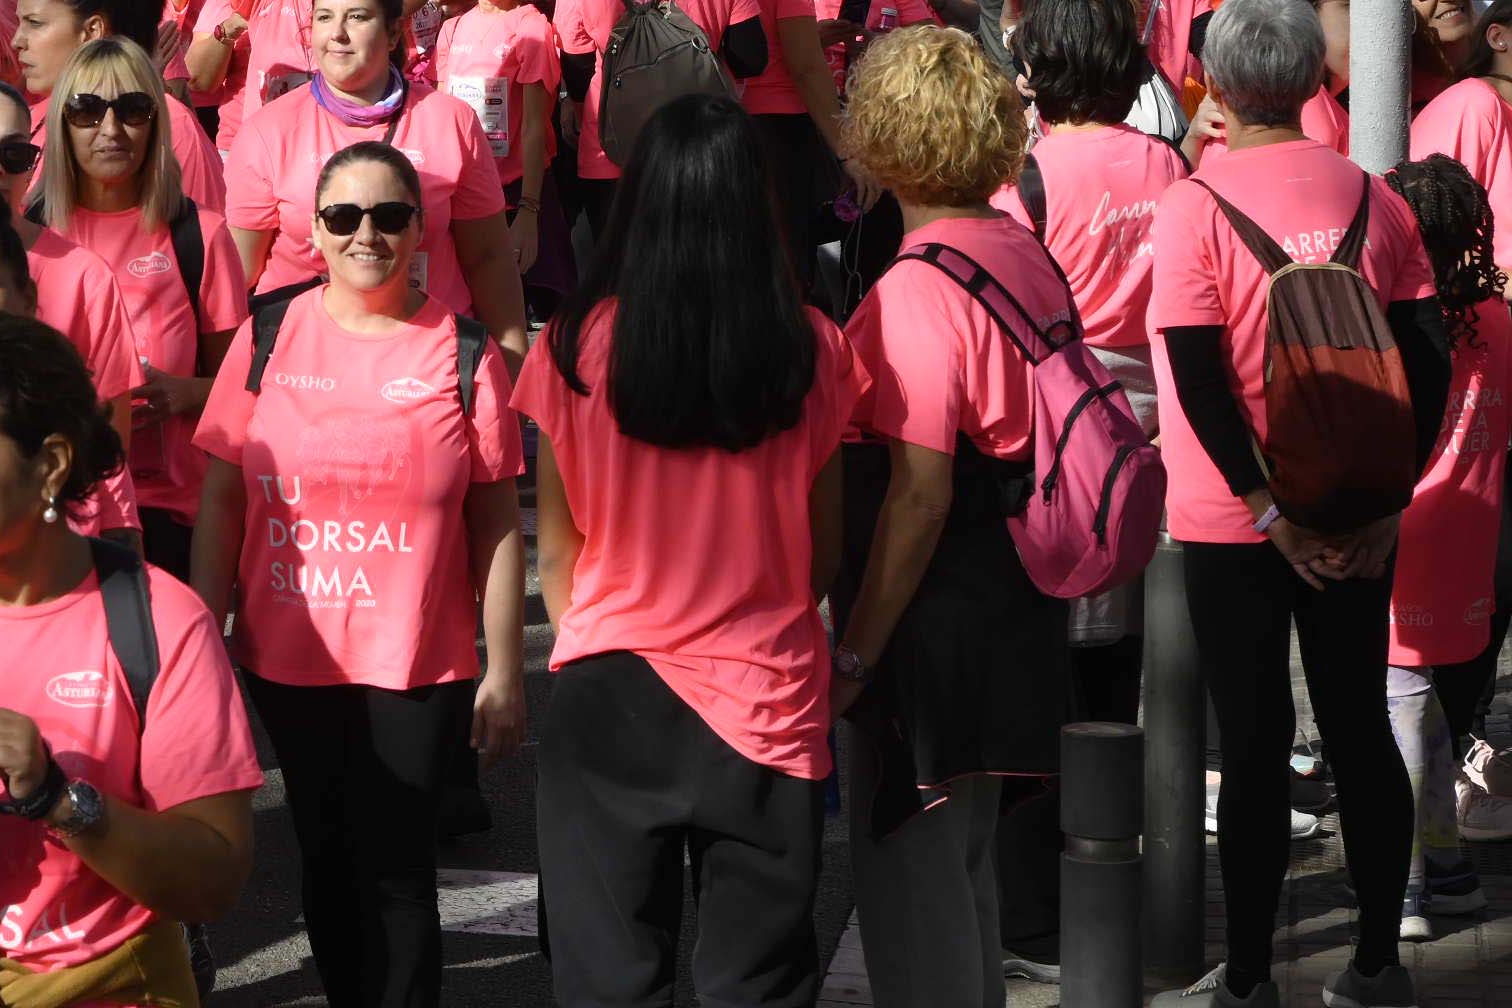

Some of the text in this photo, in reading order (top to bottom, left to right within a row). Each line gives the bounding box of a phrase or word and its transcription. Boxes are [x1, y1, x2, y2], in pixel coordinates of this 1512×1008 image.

[275, 373, 337, 391] OYSHO
[257, 474, 303, 505] TU
[267, 518, 413, 553] DORSAL
[270, 560, 373, 597] SUMA
[1396, 612, 1434, 627] SHO
